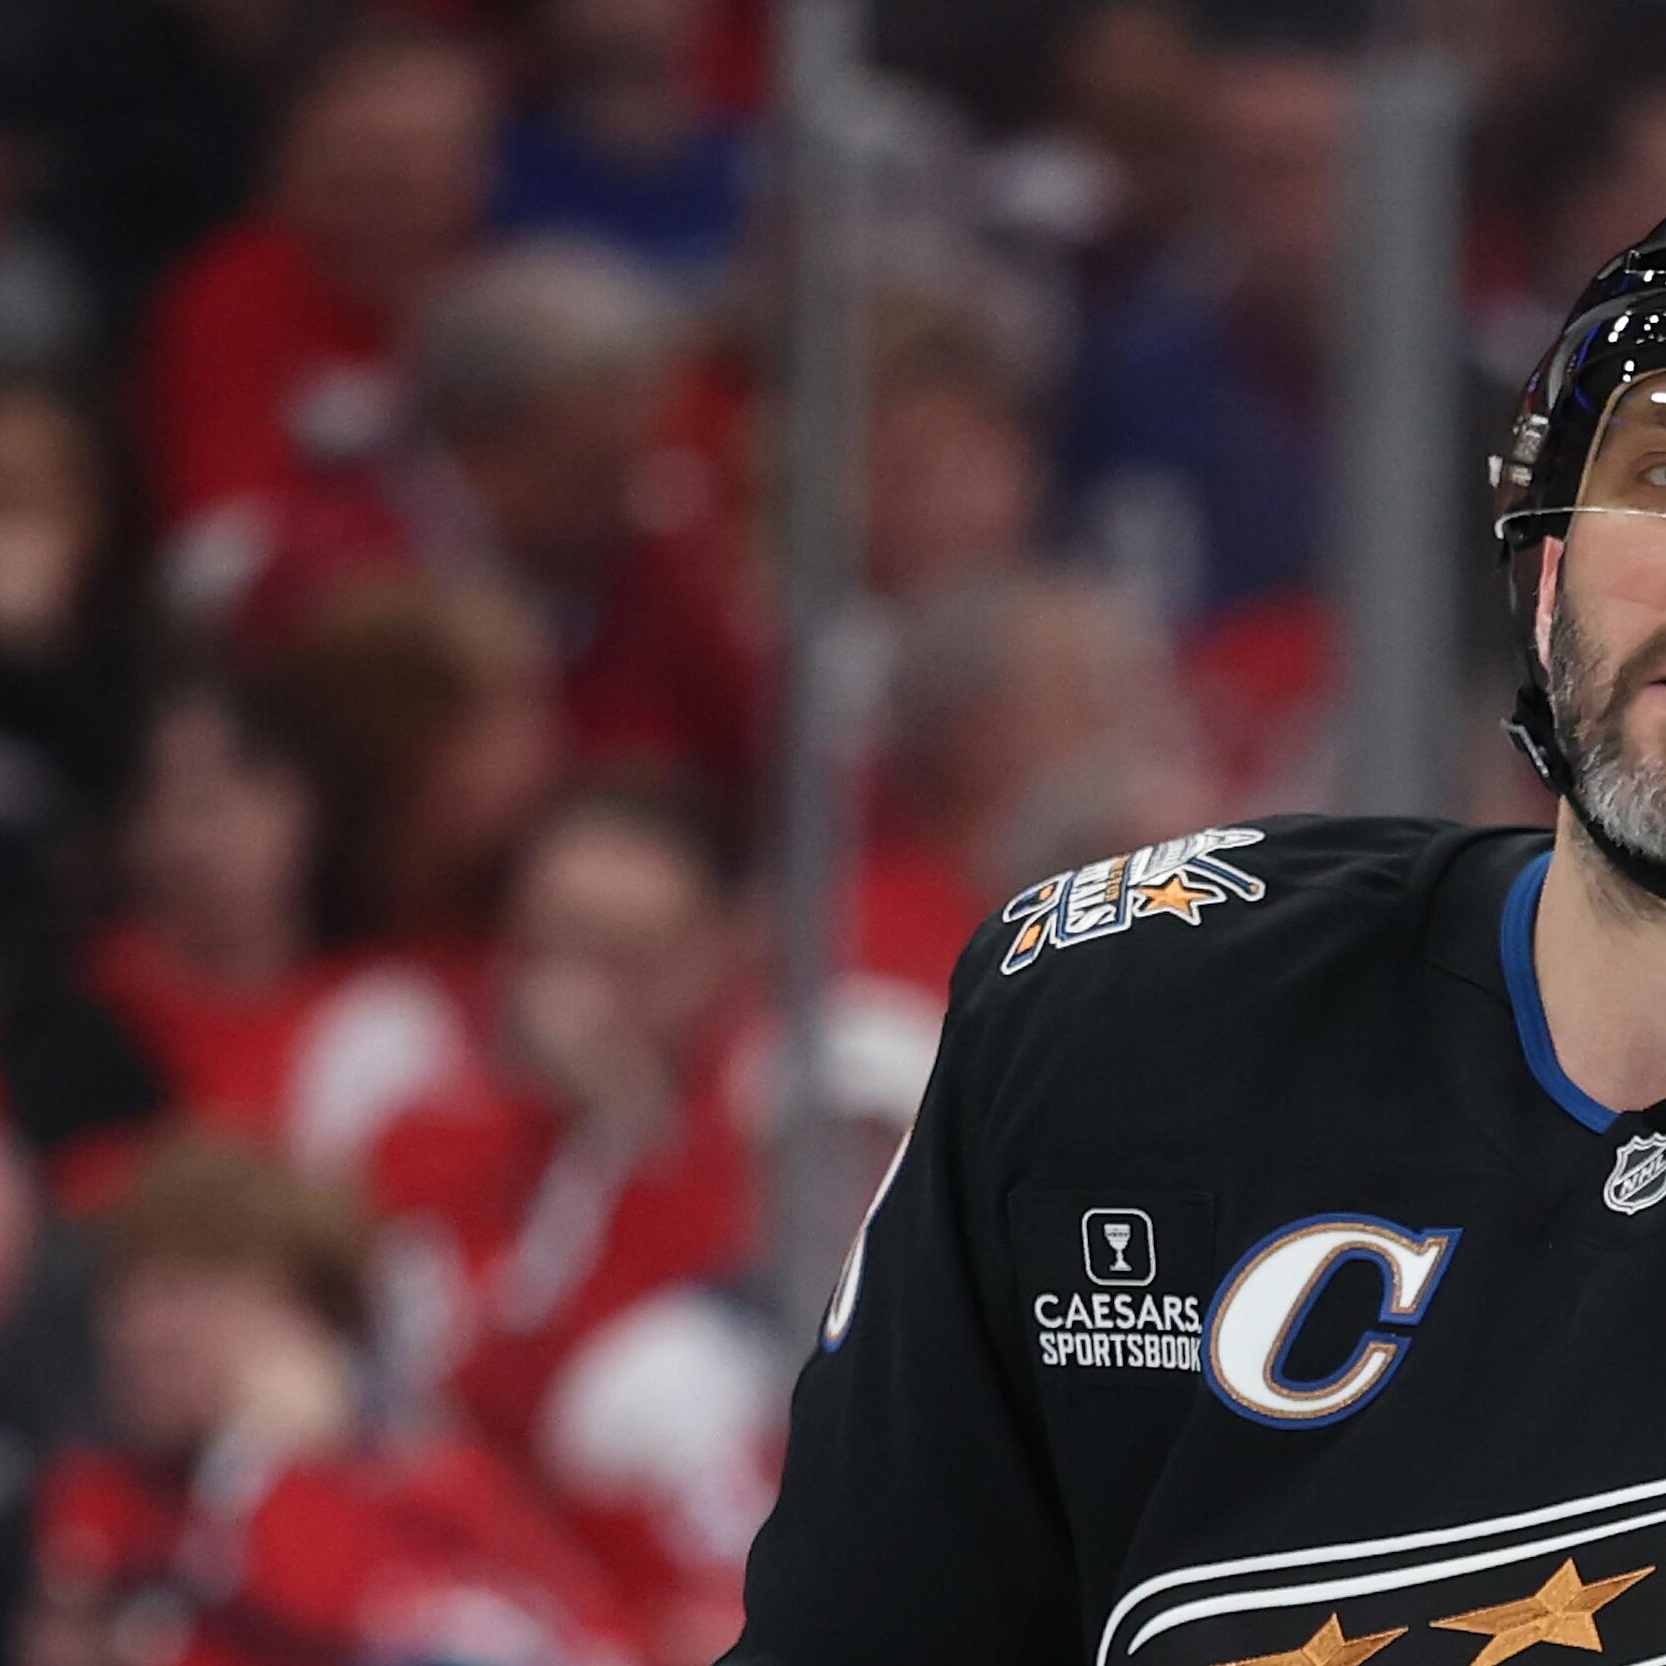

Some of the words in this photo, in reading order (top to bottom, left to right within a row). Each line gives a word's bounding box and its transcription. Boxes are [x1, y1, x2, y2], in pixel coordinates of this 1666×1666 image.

[1034, 1292, 1201, 1333] CAESARS
[1201, 1213, 1463, 1430] C
[1039, 1330, 1201, 1372] SPORTSBOOK
